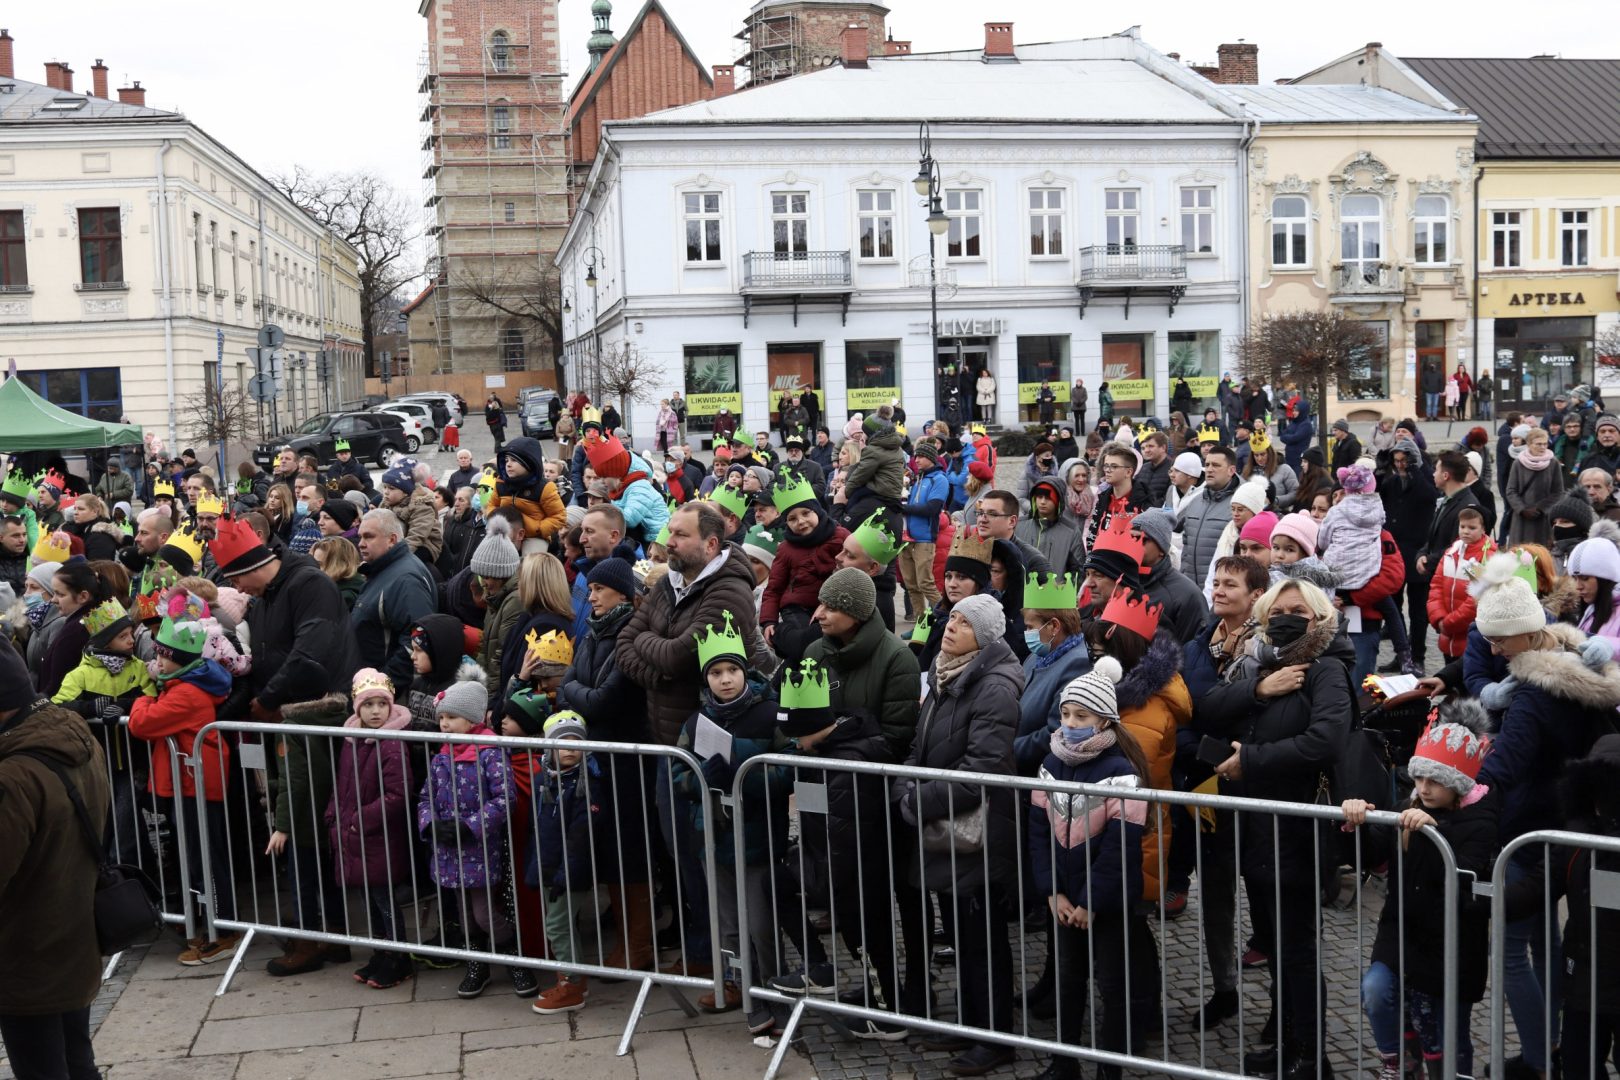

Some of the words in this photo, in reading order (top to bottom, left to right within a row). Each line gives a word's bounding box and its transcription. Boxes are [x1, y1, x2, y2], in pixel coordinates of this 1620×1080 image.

[1509, 292, 1585, 306] APTEKA
[942, 318, 982, 336] LIVE
[1104, 363, 1128, 378] NIKE
[773, 375, 801, 390] NIKE
[691, 396, 737, 404] LIKWIDACJA
[851, 391, 896, 399] LIKWIDACJA
